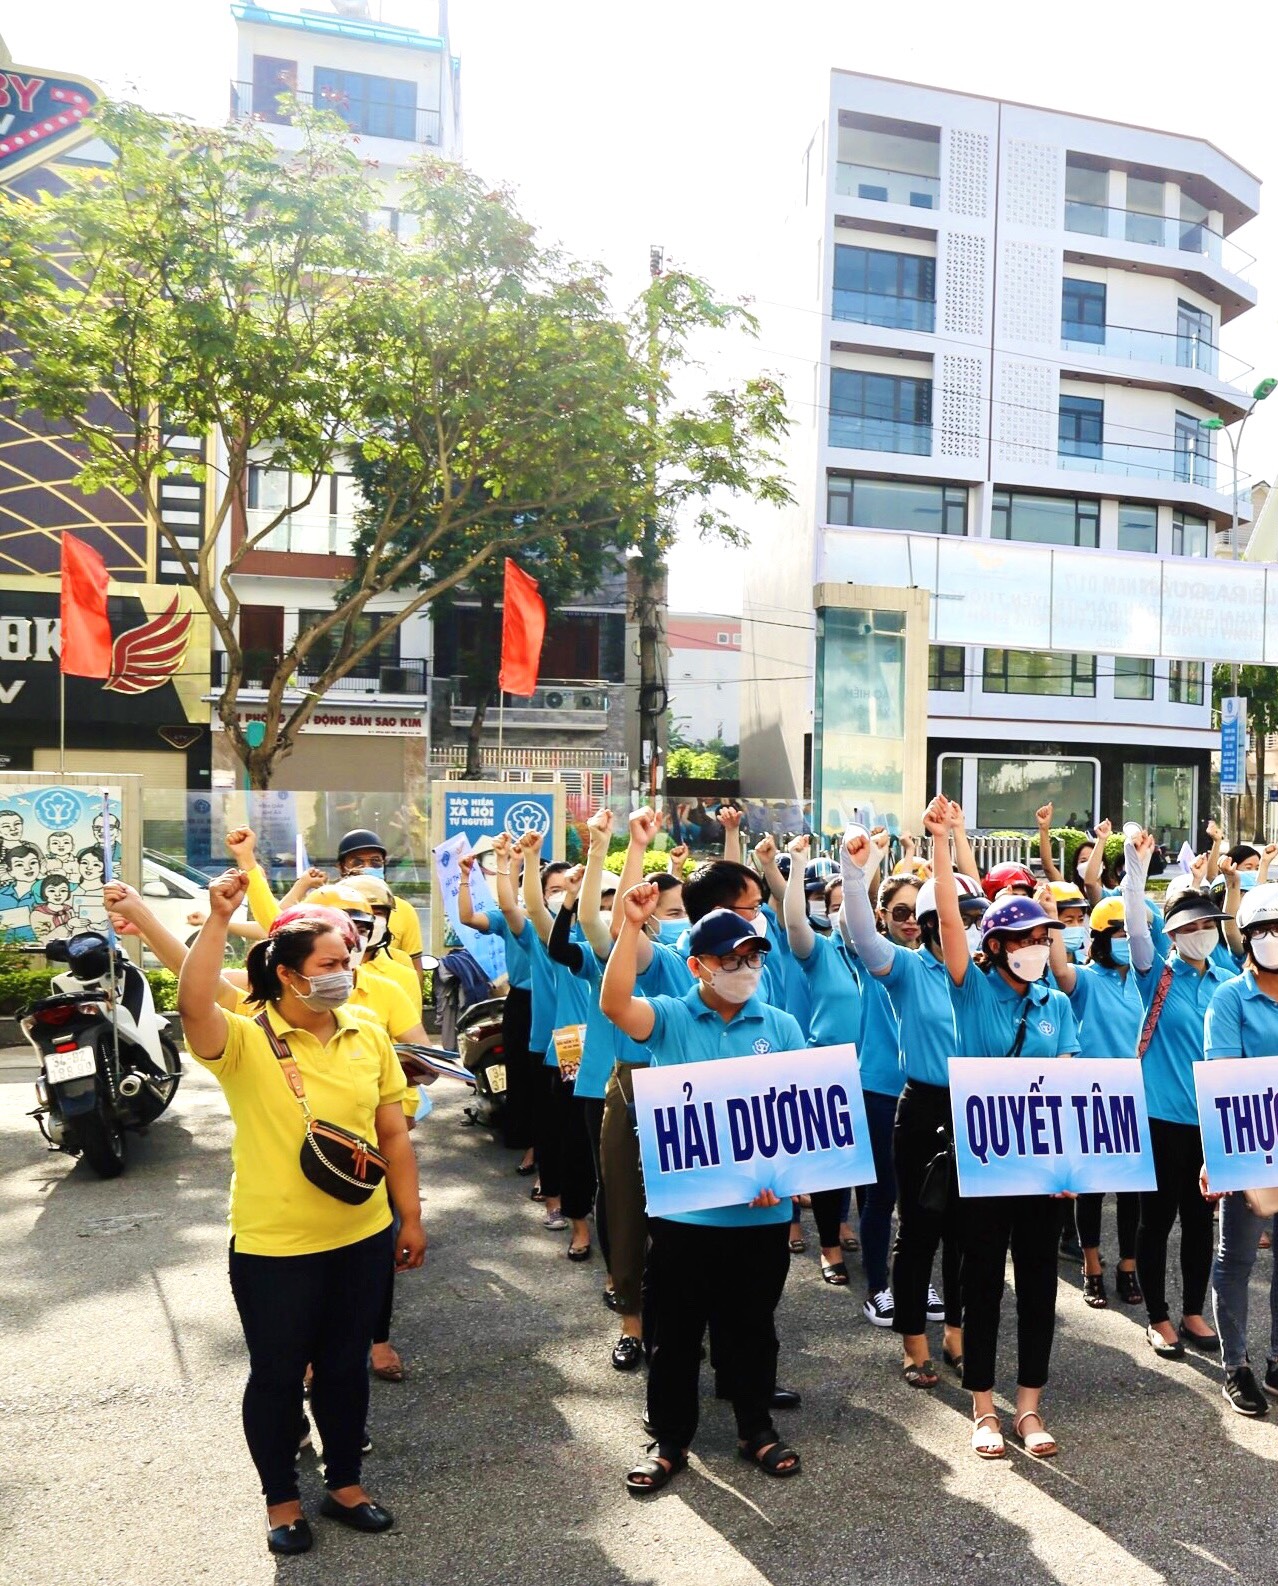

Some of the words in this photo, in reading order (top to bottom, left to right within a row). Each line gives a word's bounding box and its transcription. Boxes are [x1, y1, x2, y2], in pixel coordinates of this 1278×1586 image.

[375, 717, 397, 727] SAO
[401, 718, 422, 727] KIM
[654, 1082, 720, 1172] HẢI
[727, 1084, 854, 1162] DƯƠNG
[966, 1076, 1064, 1164] QUYẾT
[1071, 1083, 1141, 1154] TÂM
